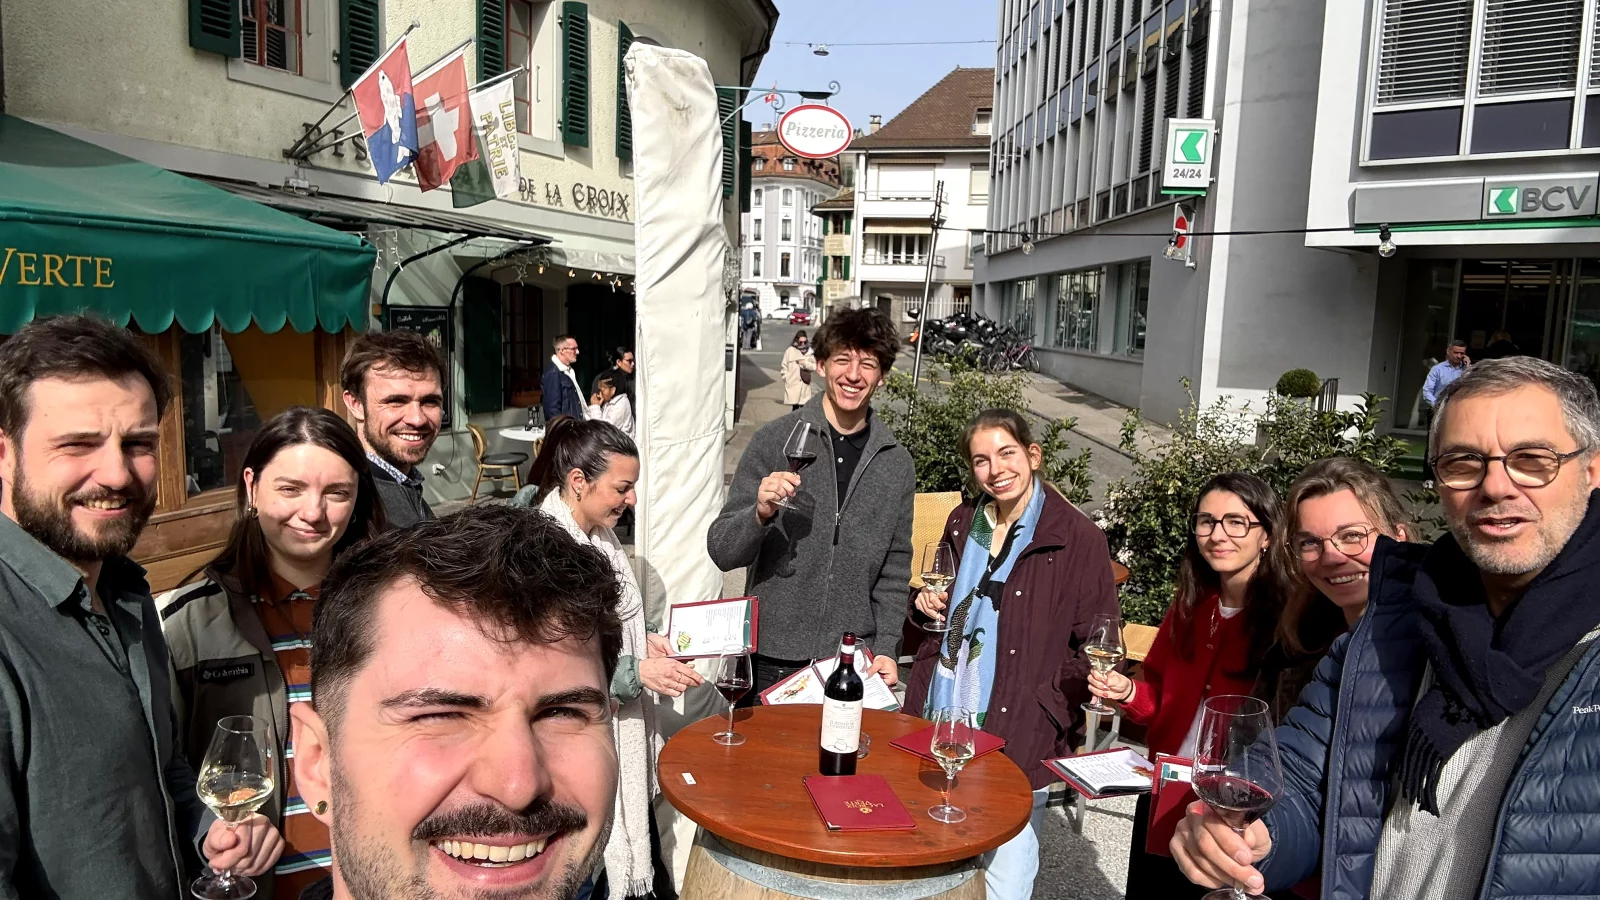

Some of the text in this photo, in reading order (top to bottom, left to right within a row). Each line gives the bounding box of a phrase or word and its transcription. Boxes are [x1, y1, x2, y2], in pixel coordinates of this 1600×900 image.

[480, 111, 509, 179] PATRIE
[1172, 168, 1202, 179] 24/24
[518, 177, 629, 213] DE LA CROIX
[1521, 185, 1592, 212] BCV
